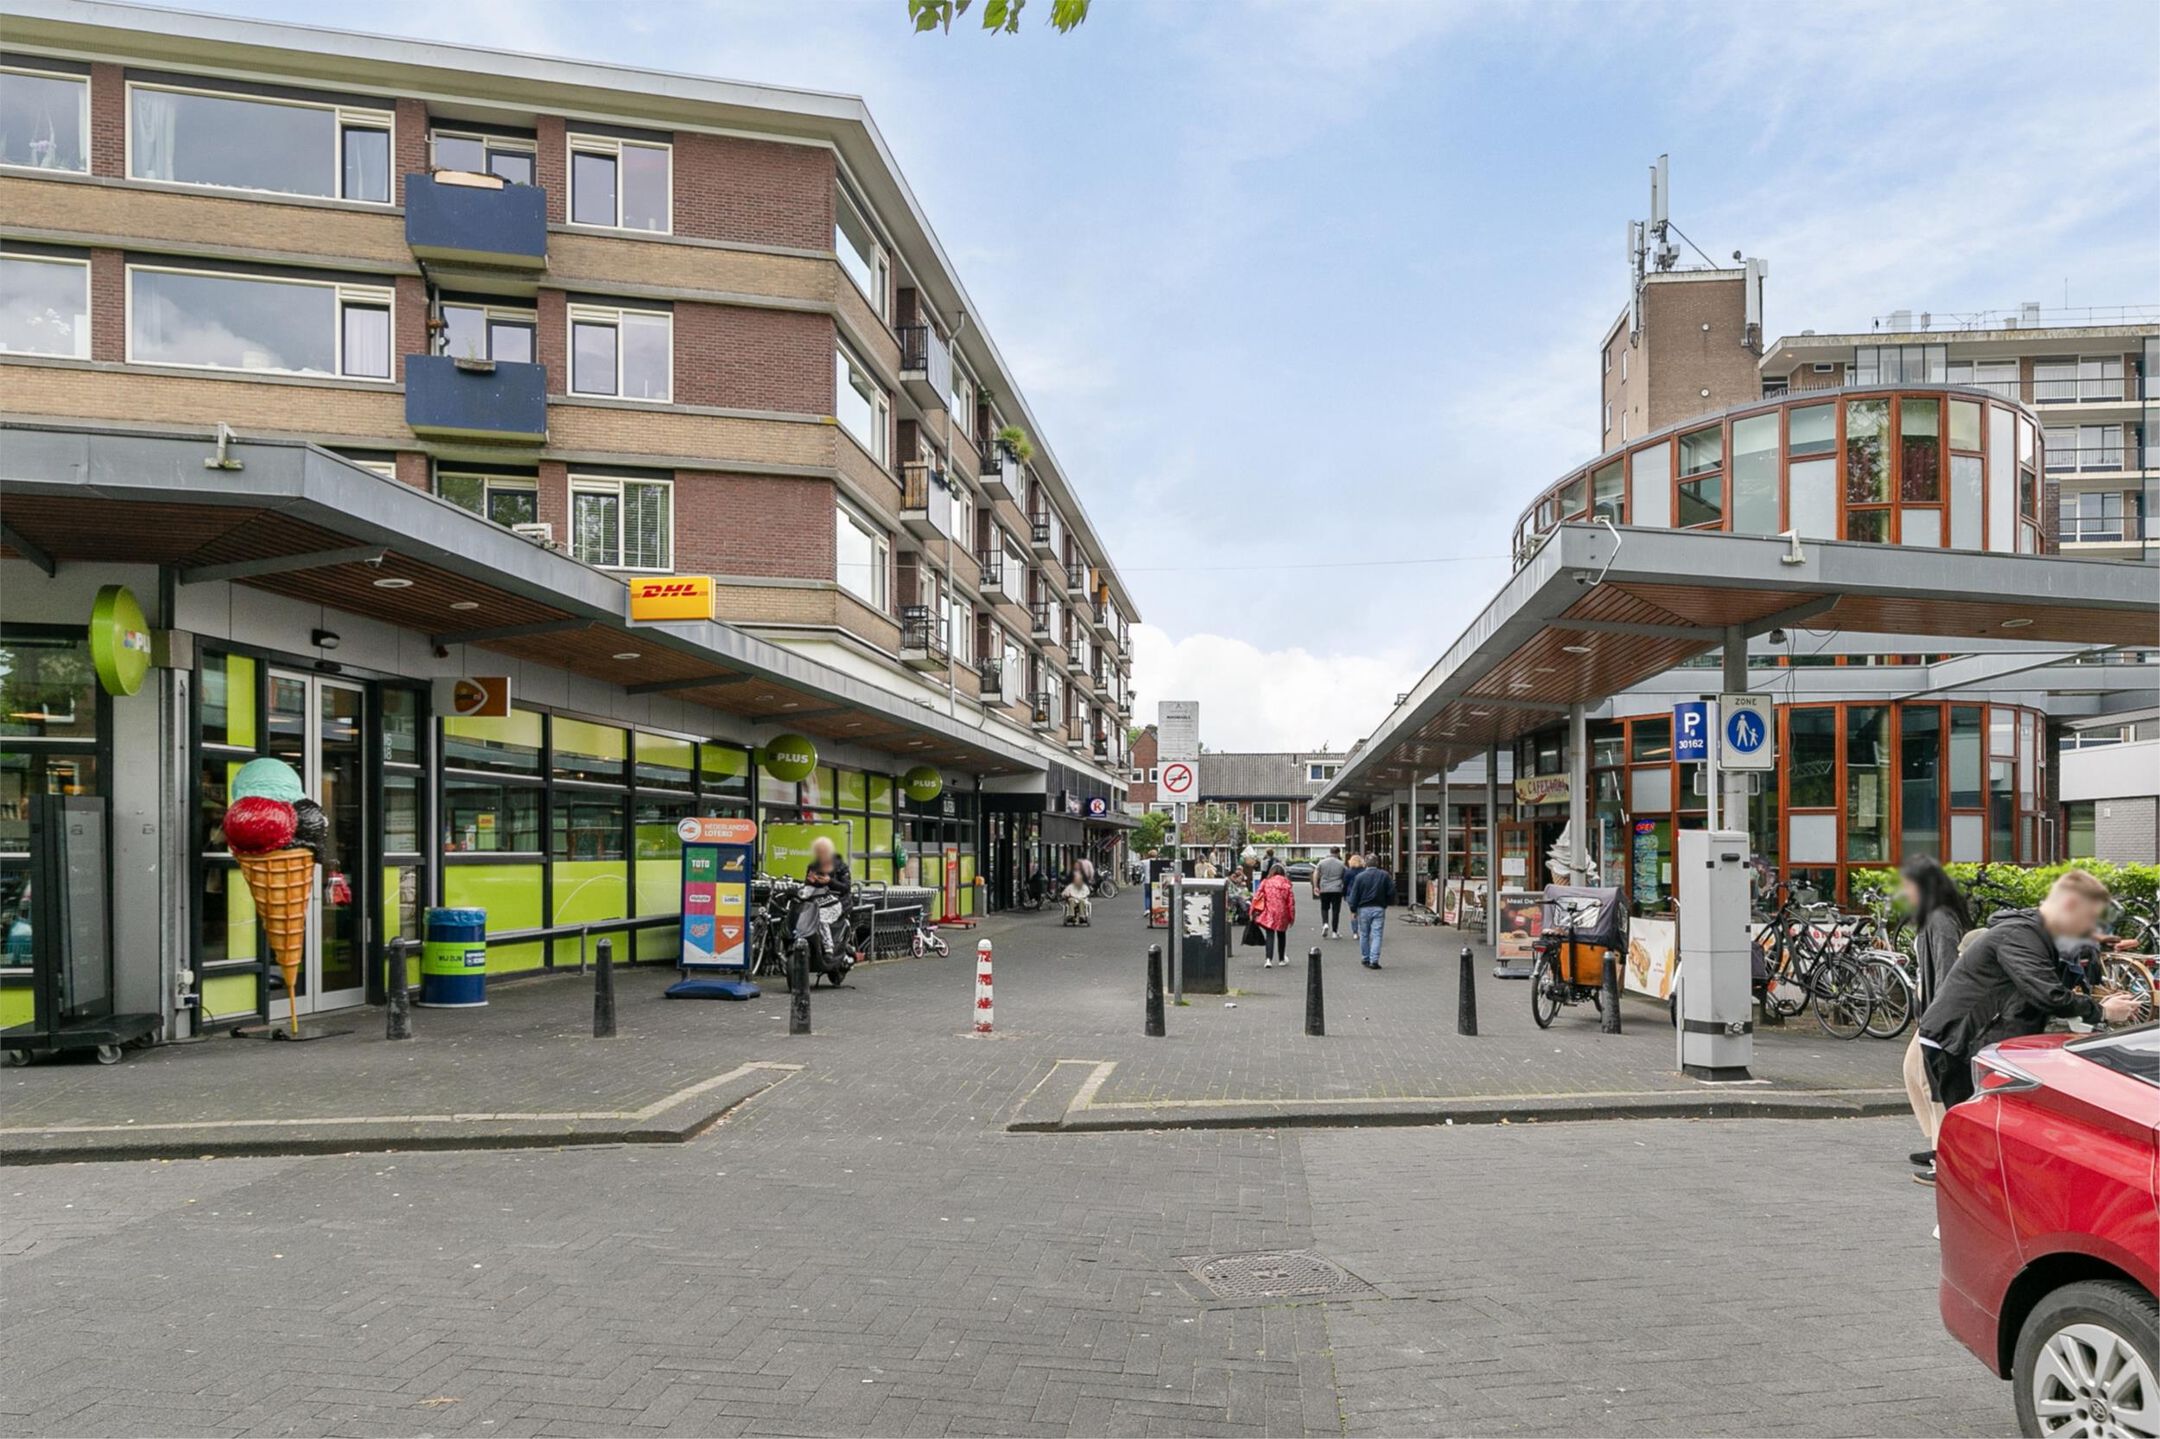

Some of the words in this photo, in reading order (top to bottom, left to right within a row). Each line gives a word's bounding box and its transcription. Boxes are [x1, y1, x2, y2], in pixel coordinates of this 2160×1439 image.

[641, 584, 699, 599] DHL
[1735, 698, 1757, 706] ZONE
[1684, 712, 1701, 734] P
[1678, 739, 1704, 749] 30162
[776, 752, 809, 764] PLUS
[912, 778, 937, 788] PLUS
[1093, 802, 1102, 811] K
[1635, 822, 1655, 832] OPEN
[691, 859, 711, 869] TOTO
[1506, 897, 1523, 905] Meal
